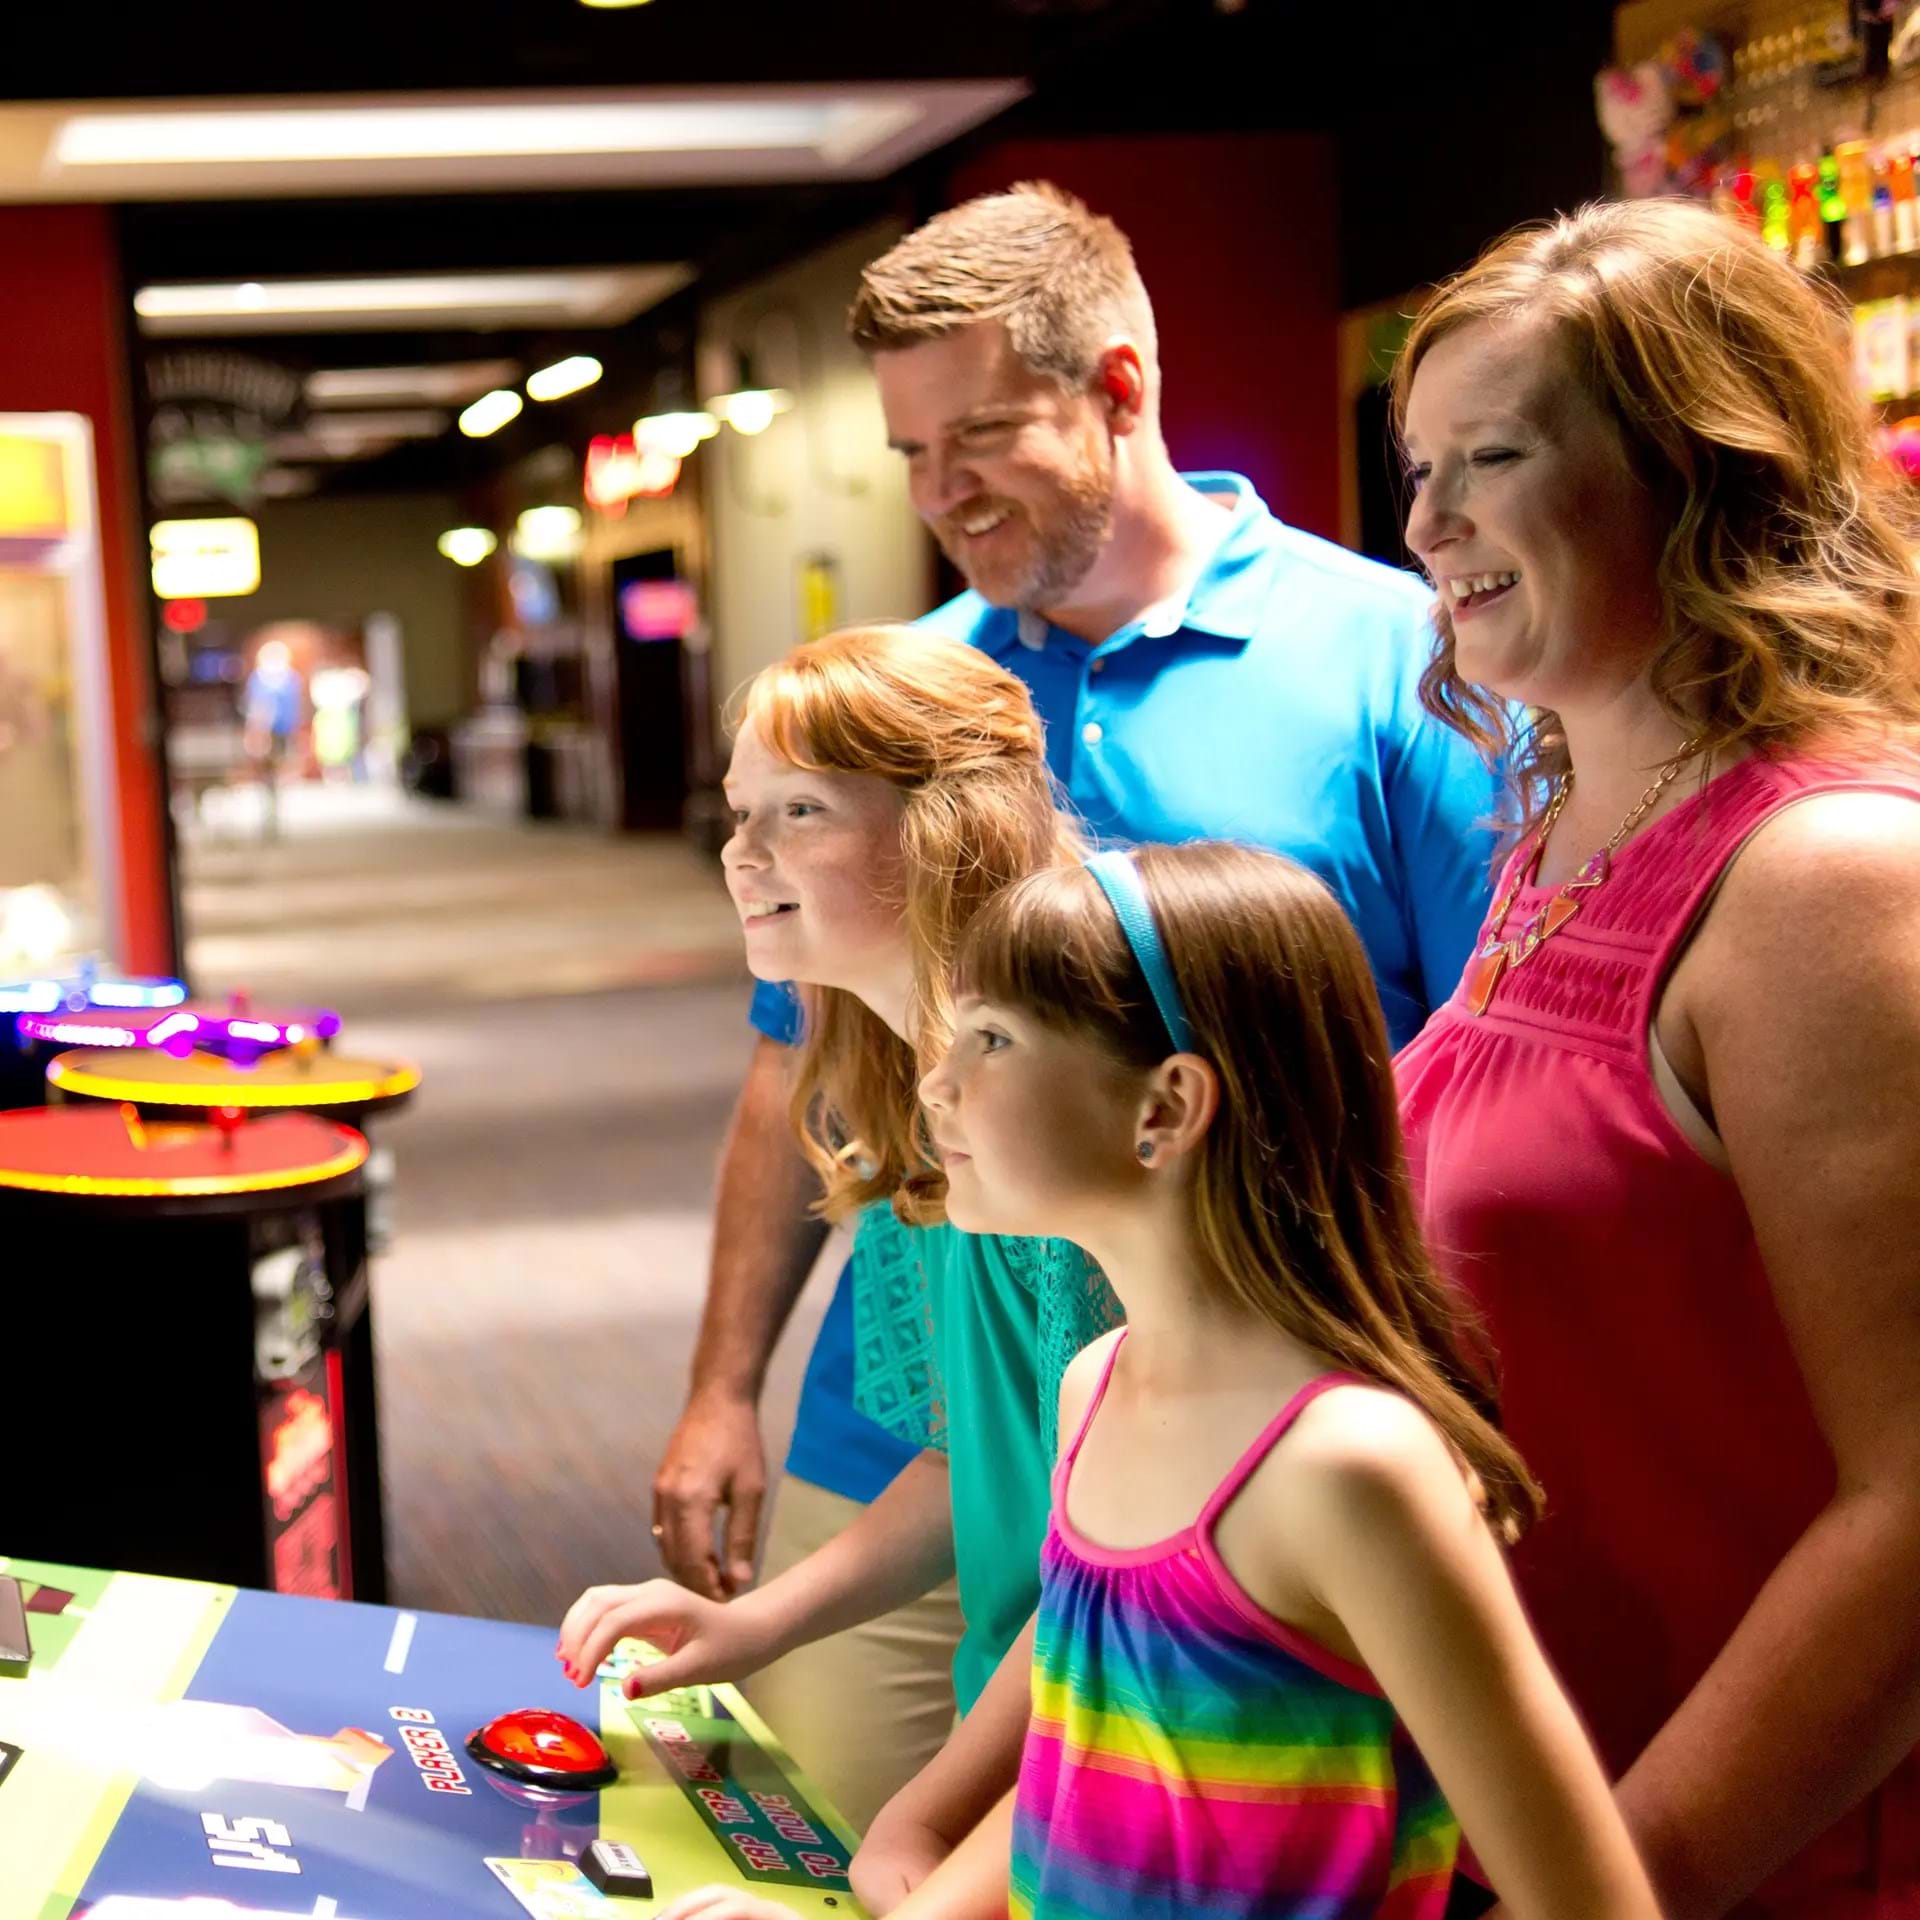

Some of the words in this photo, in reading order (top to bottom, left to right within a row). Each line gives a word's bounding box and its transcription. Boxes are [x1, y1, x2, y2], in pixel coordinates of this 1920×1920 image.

[388, 1706, 436, 1724] 2
[398, 1725, 473, 1795] PLAYER
[696, 1788, 755, 1823] TAP
[748, 1791, 823, 1844] MOVE
[200, 1812, 302, 1874] VS
[730, 1833, 791, 1871] TAP
[795, 1851, 849, 1877] TO
